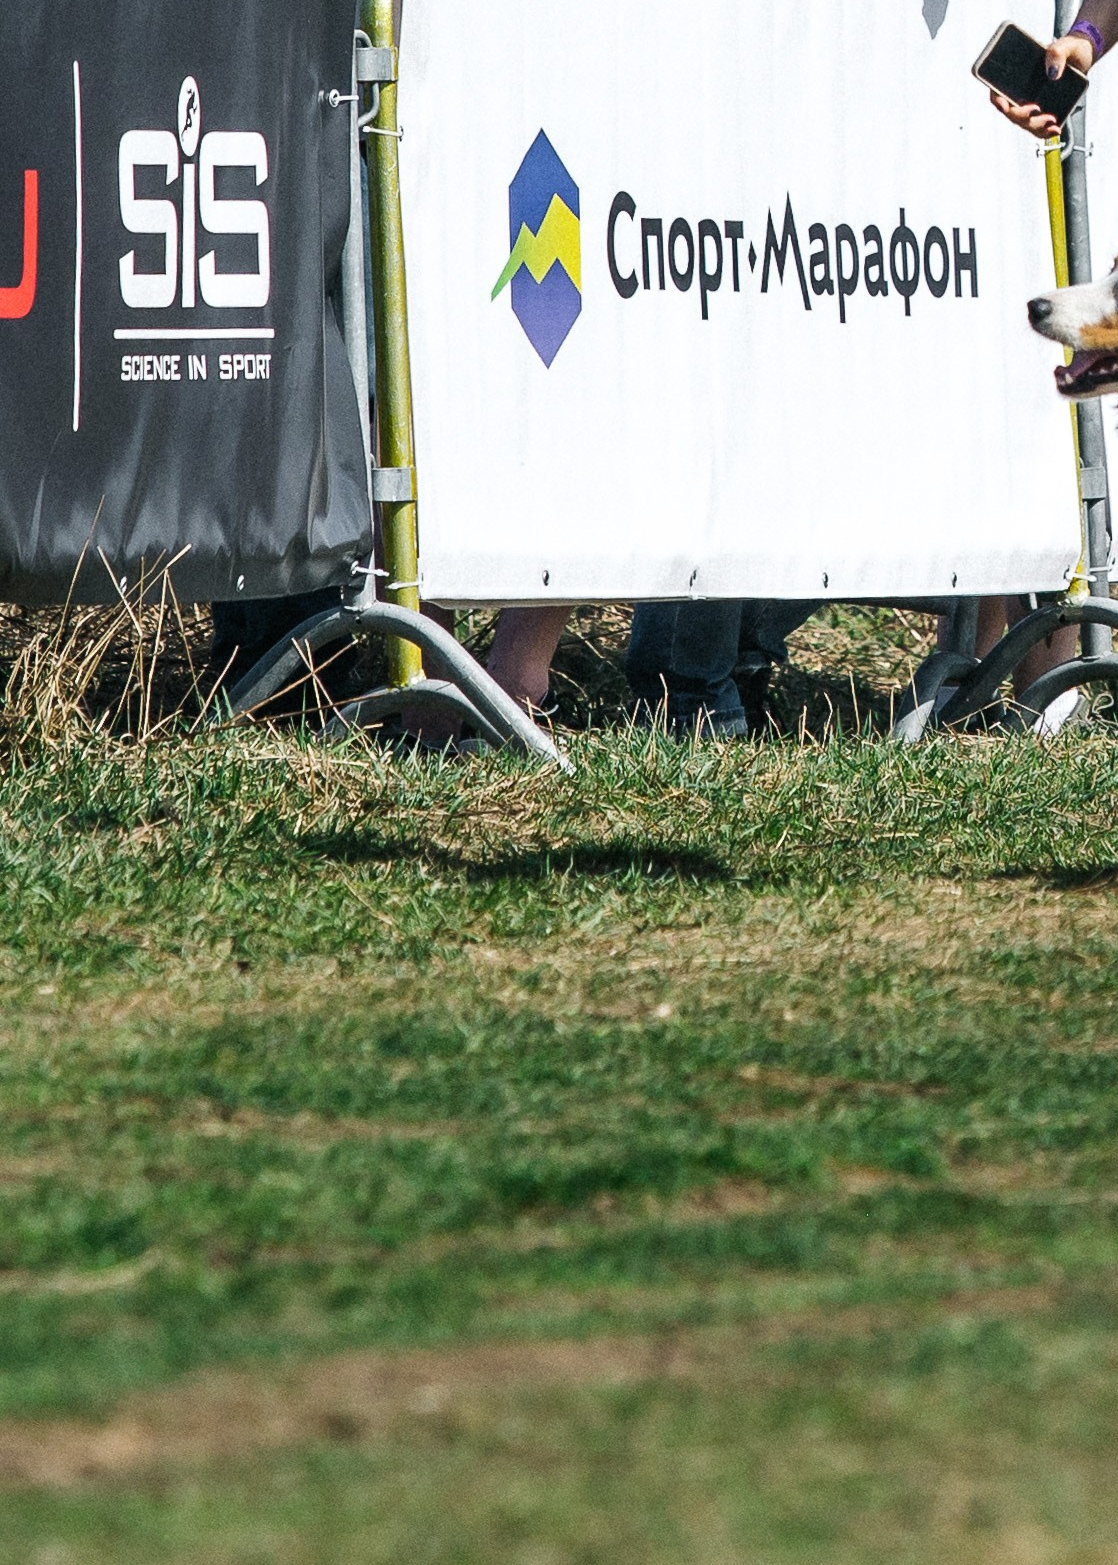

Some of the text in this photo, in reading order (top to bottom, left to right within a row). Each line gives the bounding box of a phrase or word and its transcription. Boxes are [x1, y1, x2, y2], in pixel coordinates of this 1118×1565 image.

[120, 353, 272, 382] SCIENCE IN SPORT
